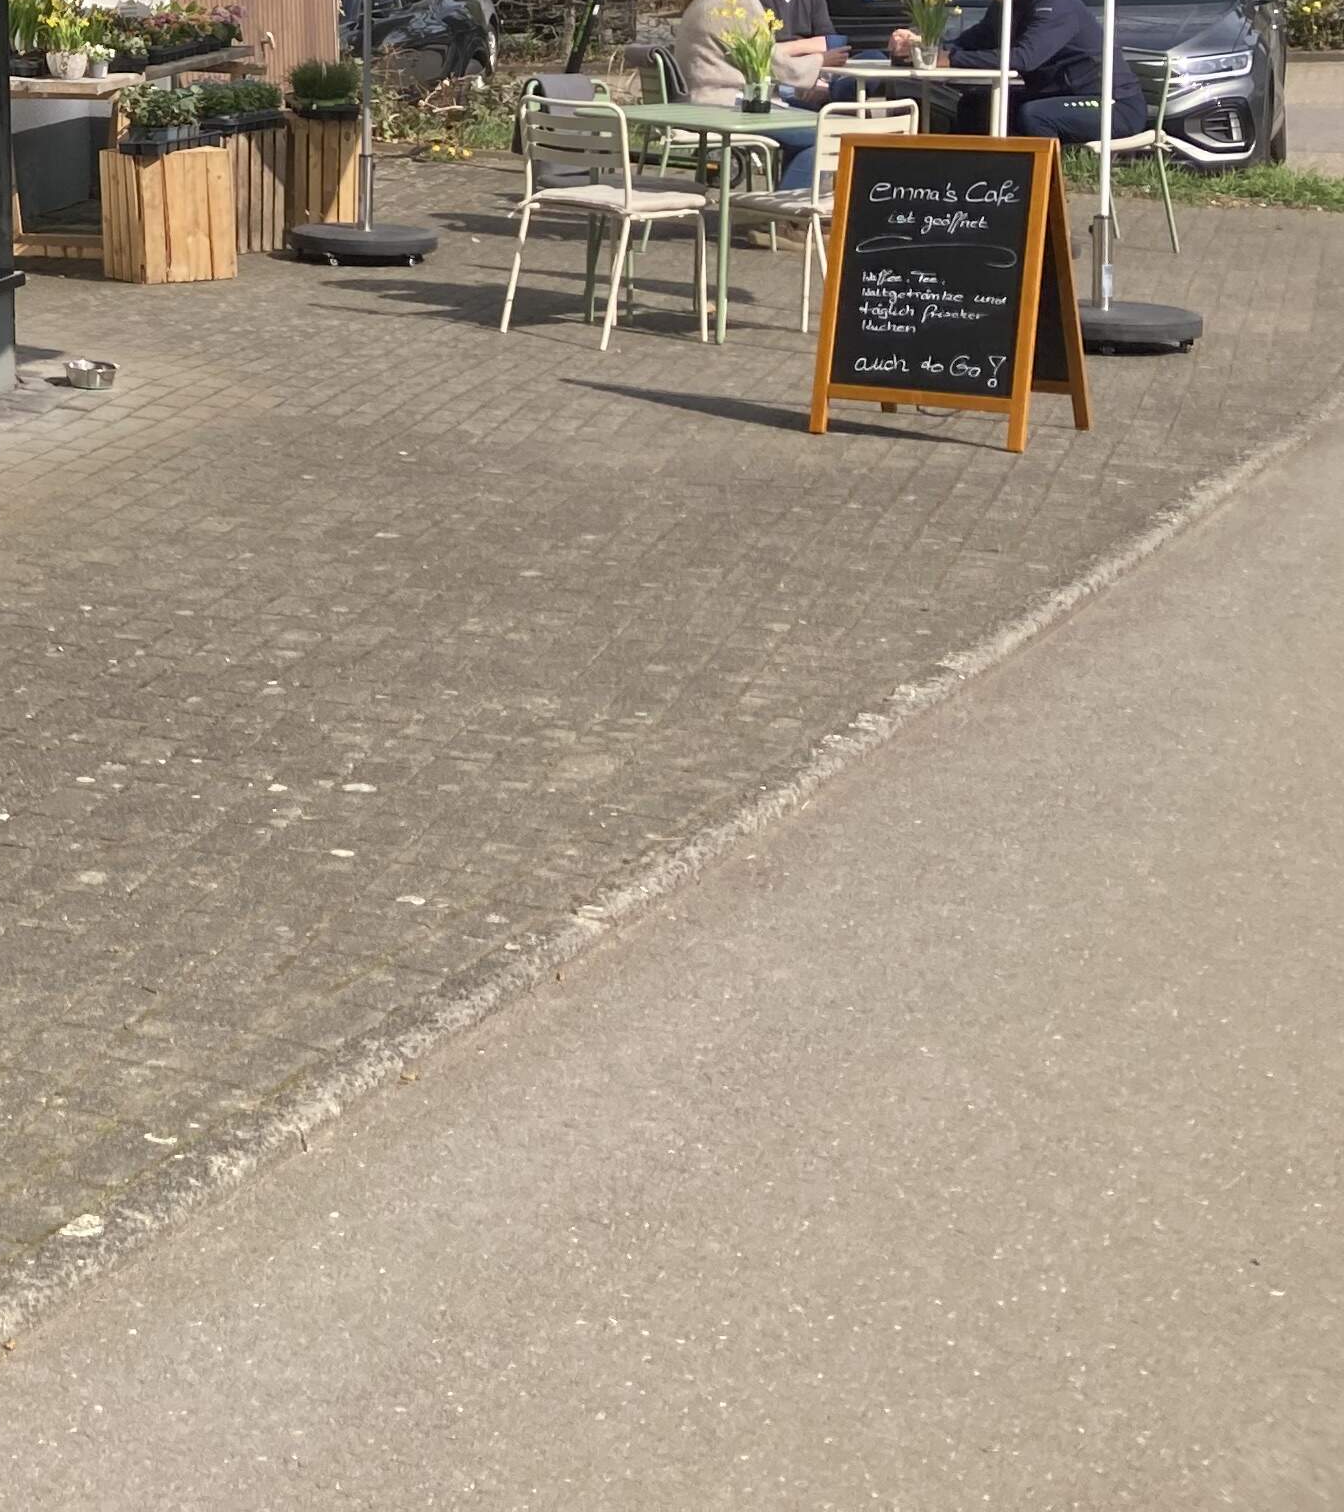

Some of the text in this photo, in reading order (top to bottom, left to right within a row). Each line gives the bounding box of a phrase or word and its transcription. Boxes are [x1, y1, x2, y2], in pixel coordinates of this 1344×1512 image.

[965, 180, 1021, 207] Café
[887, 210, 990, 235] ist geöffnet
[861, 287, 1008, 306] Kaltgetränke und
[858, 301, 990, 324] täglich frischer
[861, 319, 917, 334] Kuchen
[854, 354, 910, 372] auch
